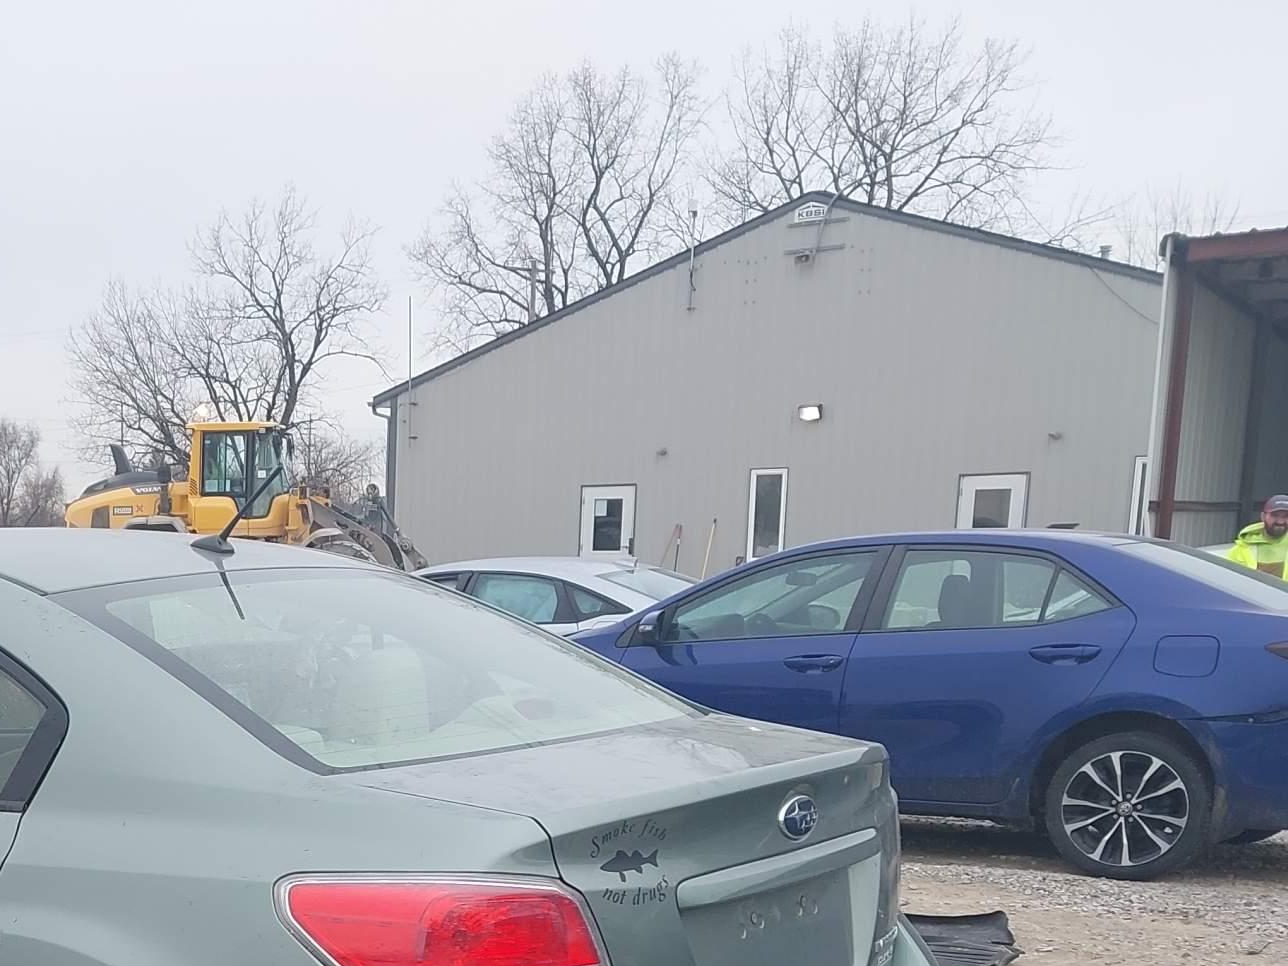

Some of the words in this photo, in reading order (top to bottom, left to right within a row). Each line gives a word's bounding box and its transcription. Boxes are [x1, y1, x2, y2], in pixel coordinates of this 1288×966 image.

[590, 820, 635, 858] Smoke
[638, 819, 667, 840] fish
[602, 887, 627, 905] not
[632, 874, 669, 906] drugs
